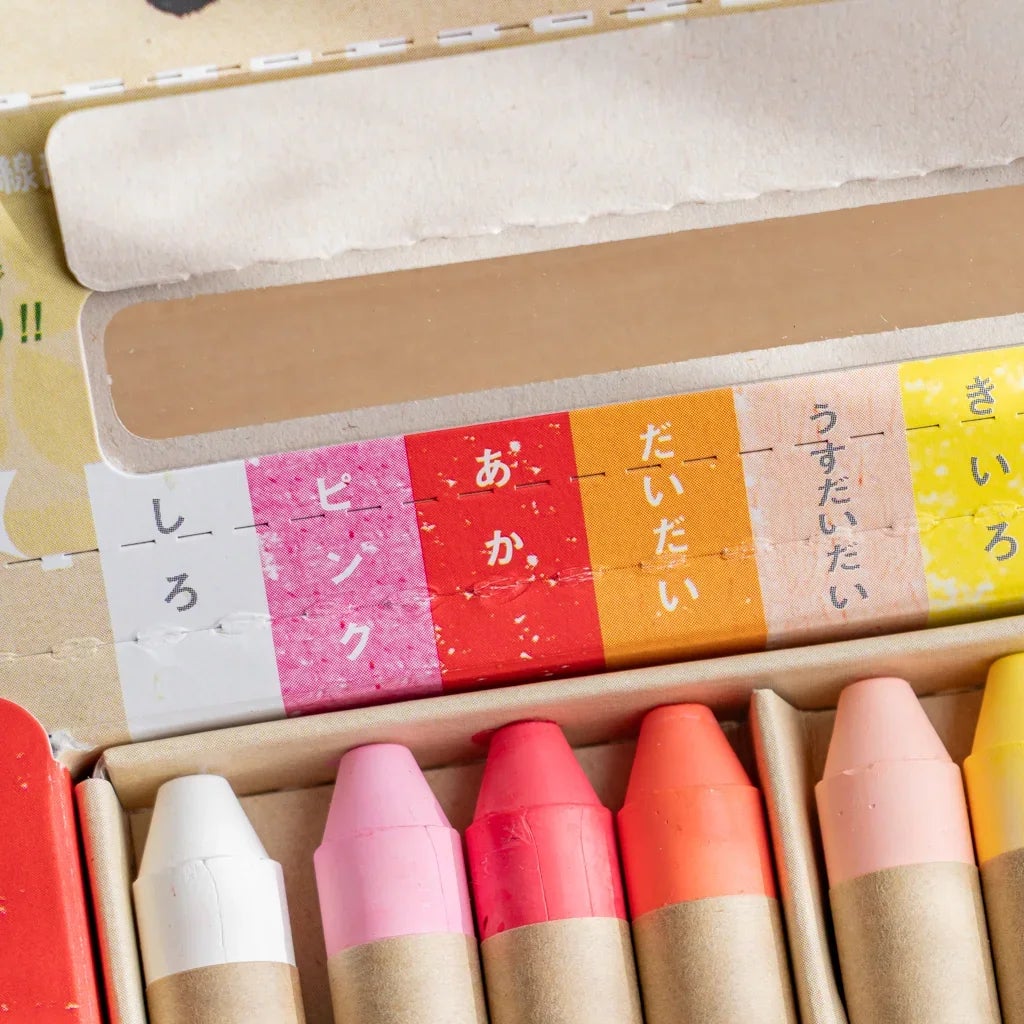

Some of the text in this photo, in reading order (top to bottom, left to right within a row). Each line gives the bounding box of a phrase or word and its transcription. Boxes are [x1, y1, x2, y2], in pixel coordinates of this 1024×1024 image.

[151, 497, 199, 613] しろ
[474, 447, 526, 567] あか
[639, 420, 700, 613] だいだい
[809, 403, 869, 610] うすだいだい
[965, 375, 1018, 561] きいろ
[316, 472, 373, 660] ピンク
